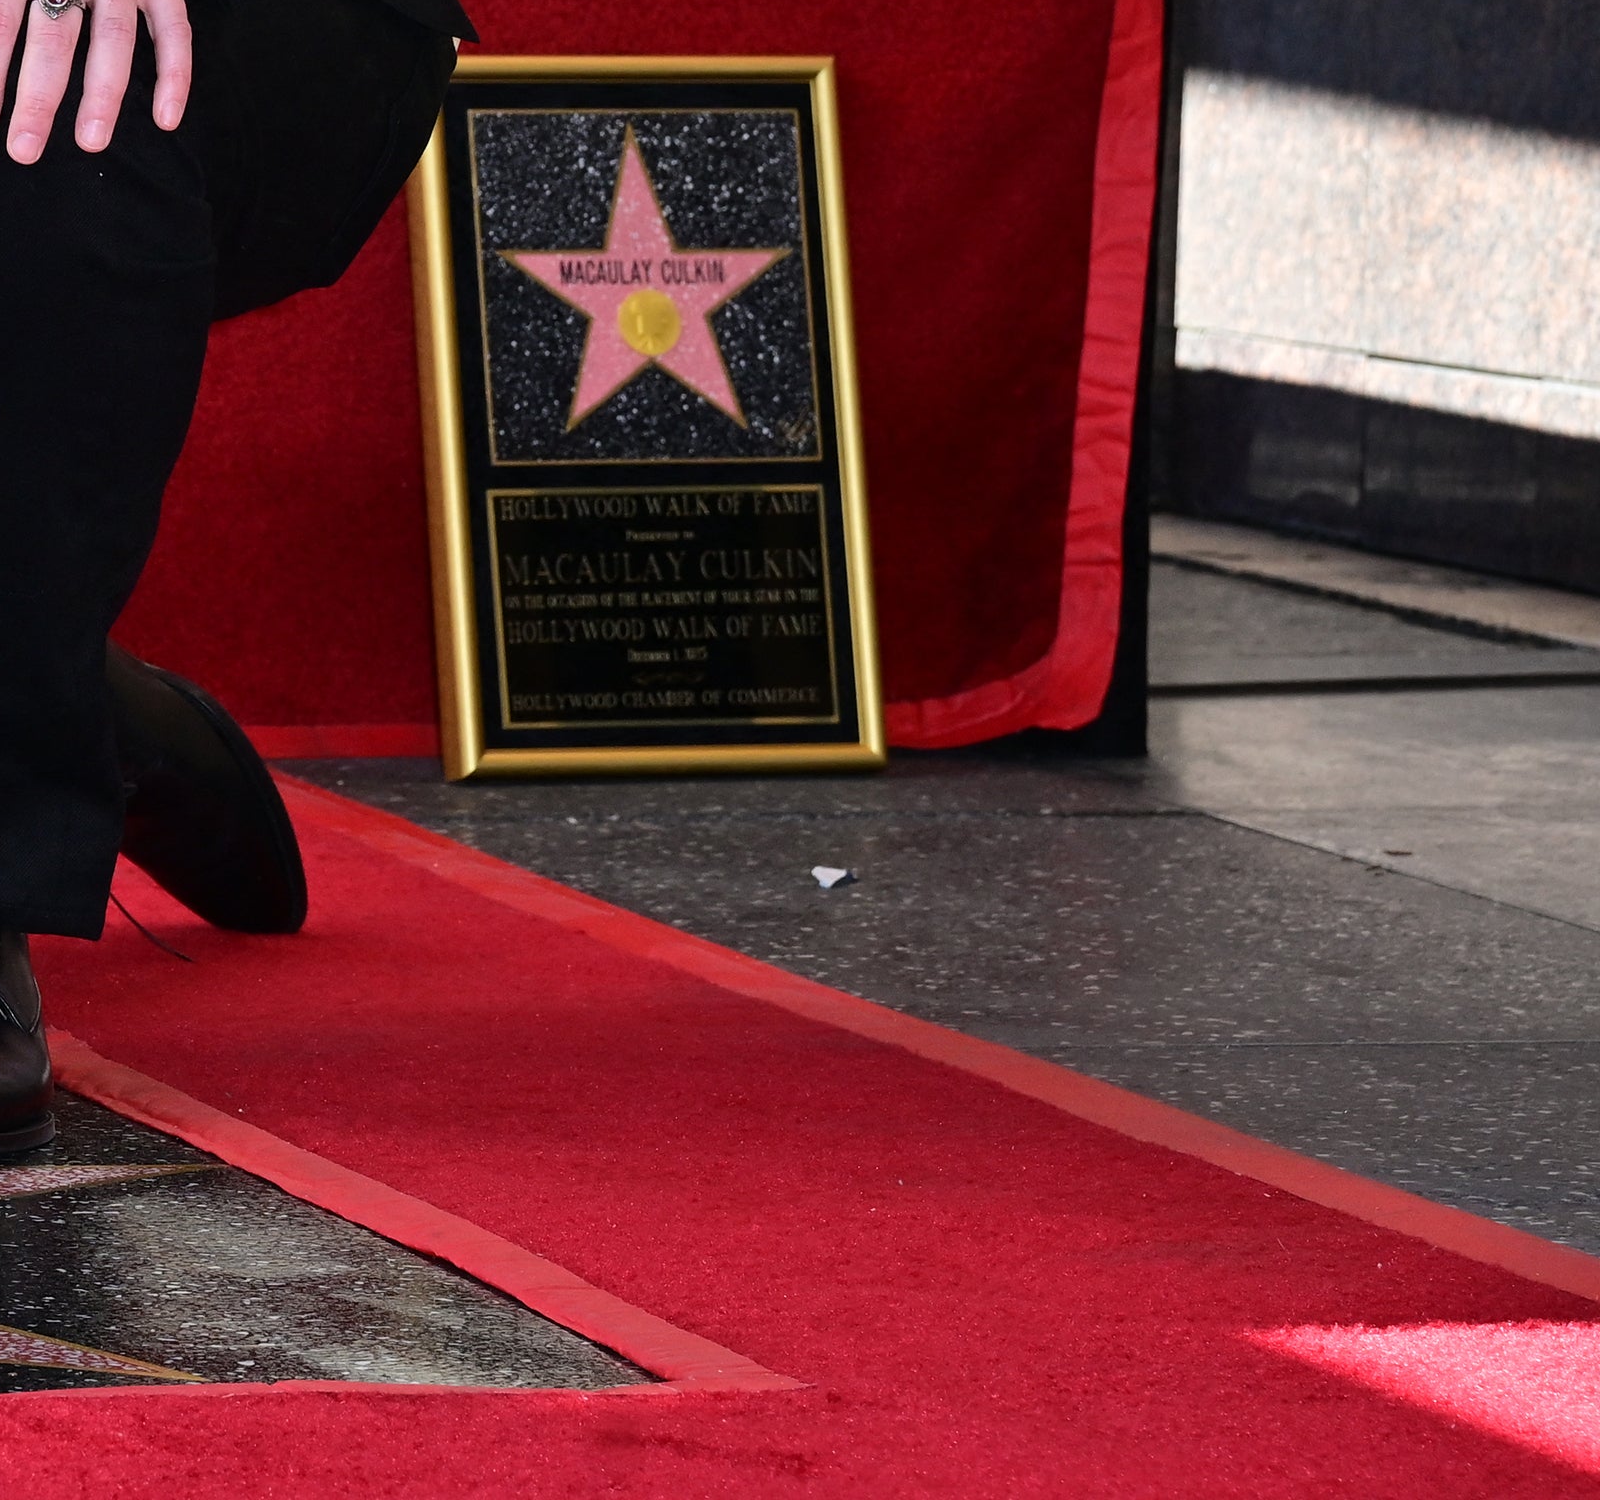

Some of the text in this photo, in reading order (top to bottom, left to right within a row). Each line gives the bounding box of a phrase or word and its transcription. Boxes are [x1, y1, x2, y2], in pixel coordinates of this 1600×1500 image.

[559, 258, 726, 285] MACAULAY CULKIN
[500, 491, 816, 520] HOLLYWOOD WALK OF FAME
[504, 547, 820, 585] MACAULAY CULKIN
[507, 612, 824, 644] HOLLYWOOD WALK OF FAME
